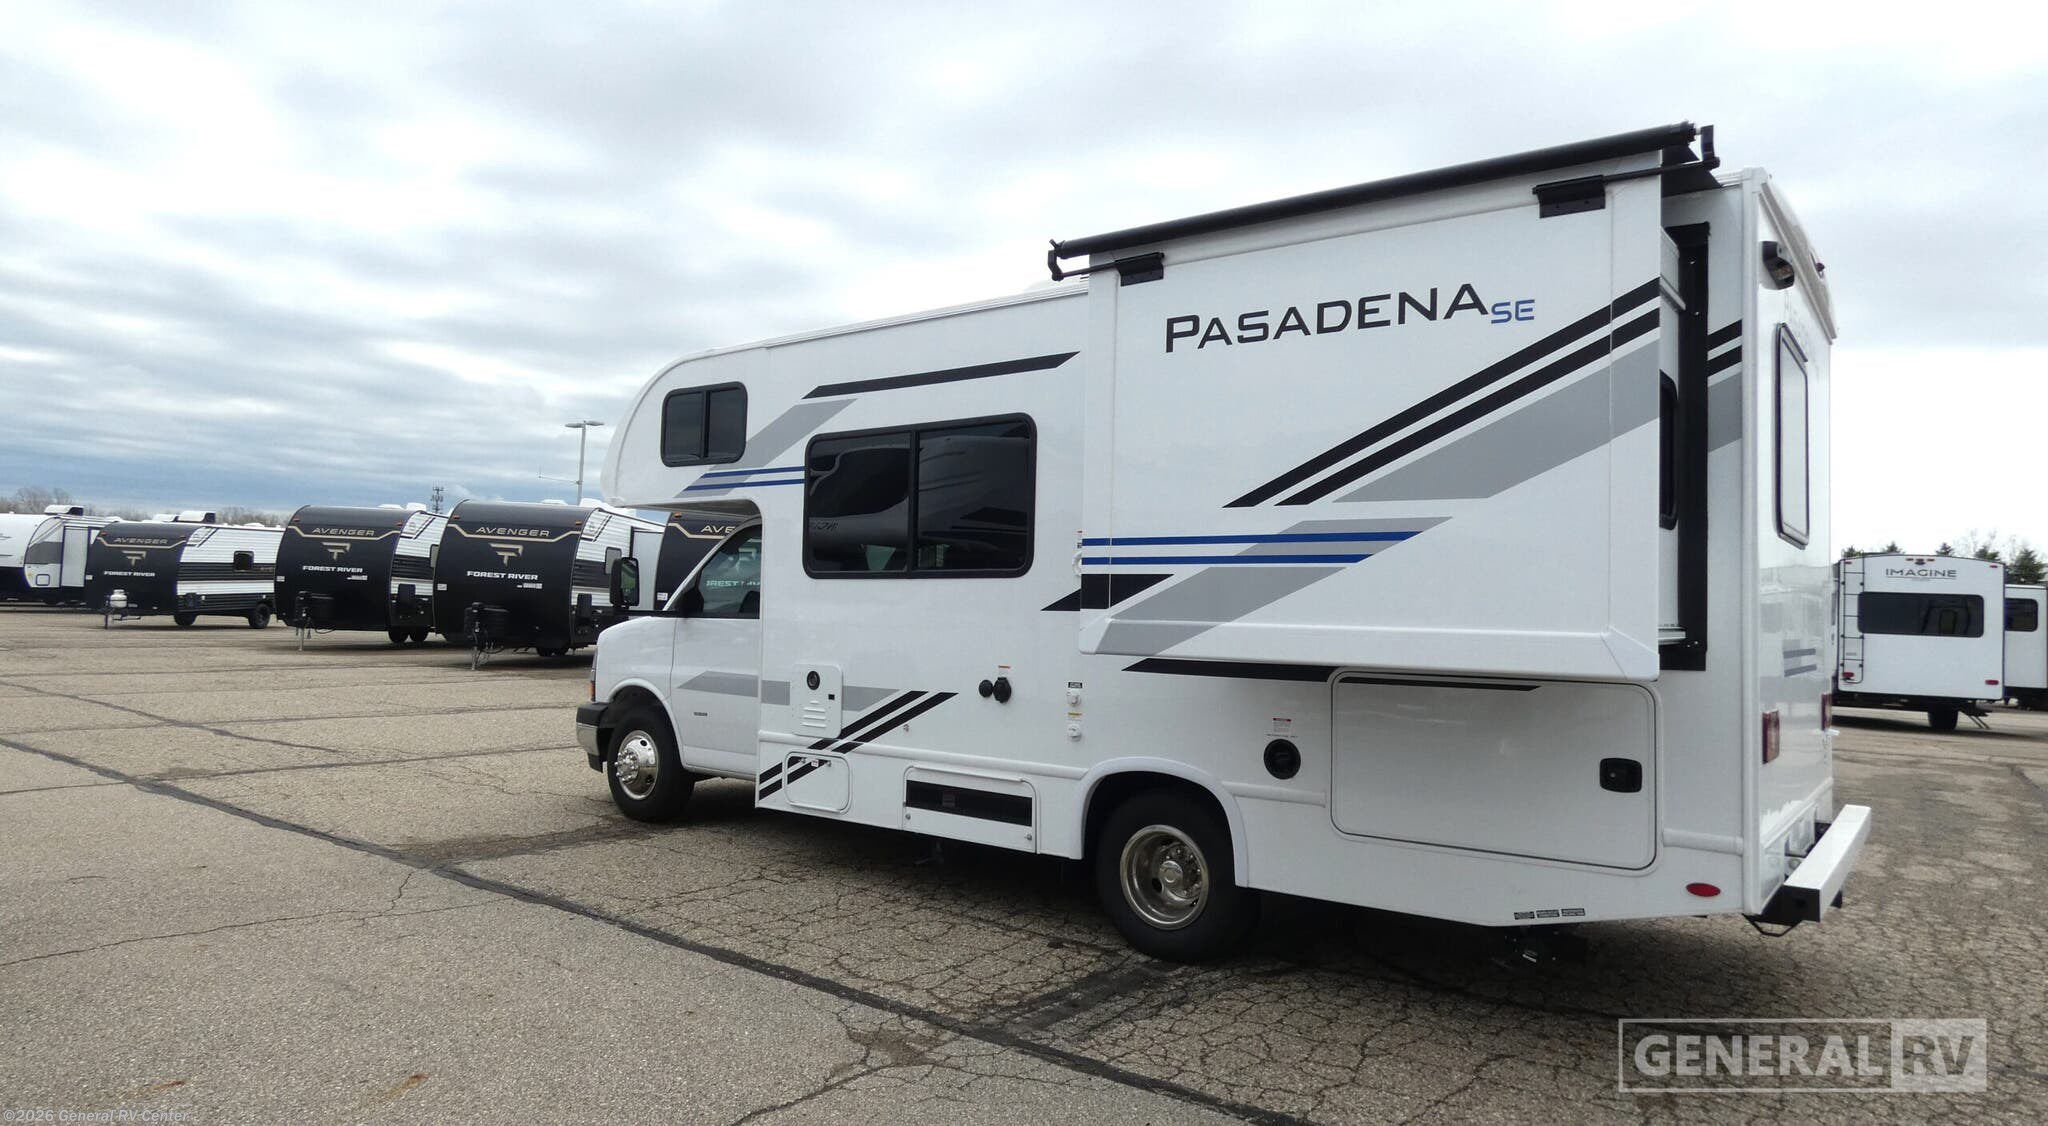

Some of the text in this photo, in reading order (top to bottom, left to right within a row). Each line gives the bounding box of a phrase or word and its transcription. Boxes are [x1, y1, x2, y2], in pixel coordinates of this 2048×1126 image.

[1165, 283, 1535, 353] PASADENA SE
[312, 527, 375, 537] AVENGER
[475, 526, 550, 537] AVENGER
[467, 570, 506, 579] FOREST
[1885, 568, 1957, 578] IMAGINE
